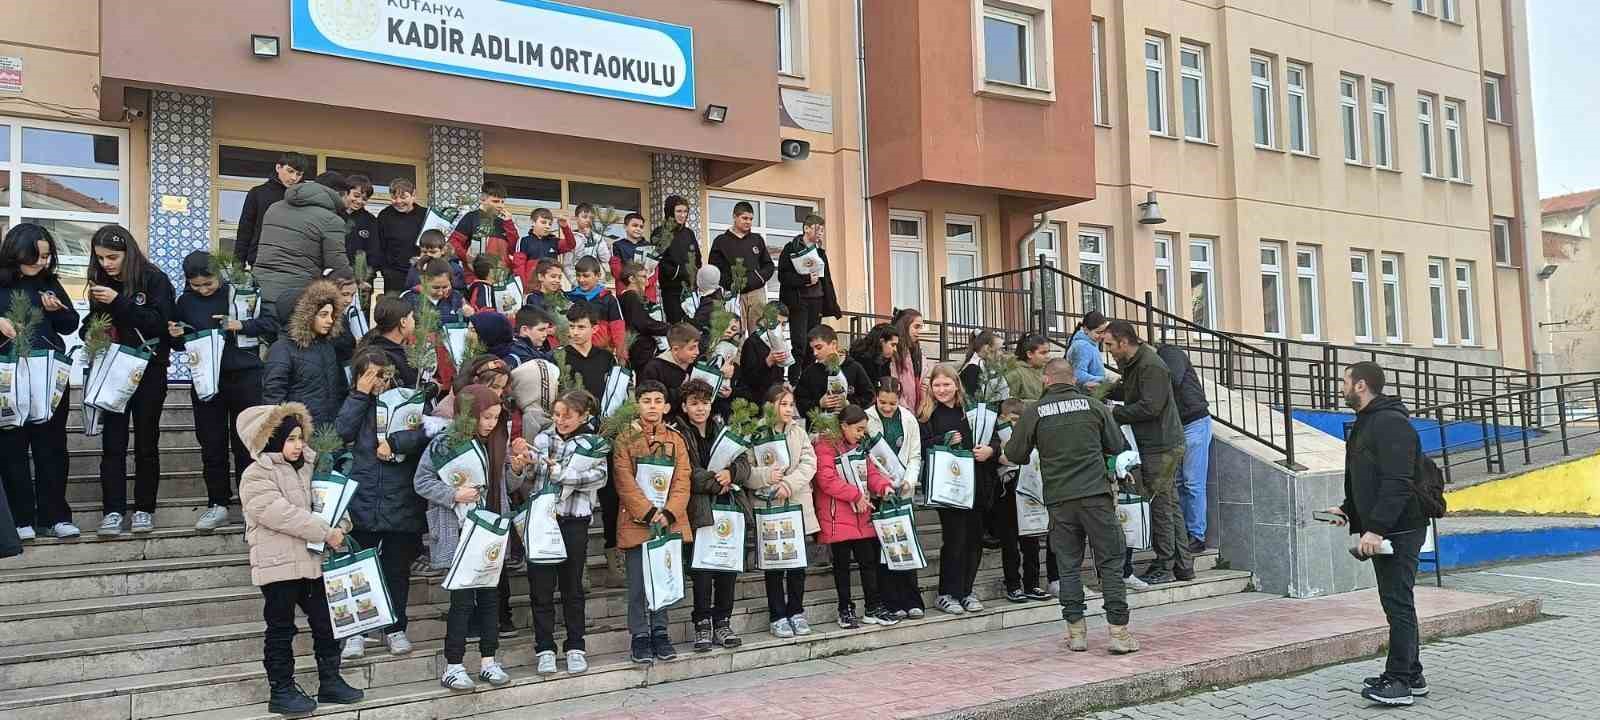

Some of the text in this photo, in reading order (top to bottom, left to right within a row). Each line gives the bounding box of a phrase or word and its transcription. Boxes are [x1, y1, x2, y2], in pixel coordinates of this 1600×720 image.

[387, 17, 675, 87] KADİR ADLIM ORTAOKULU
